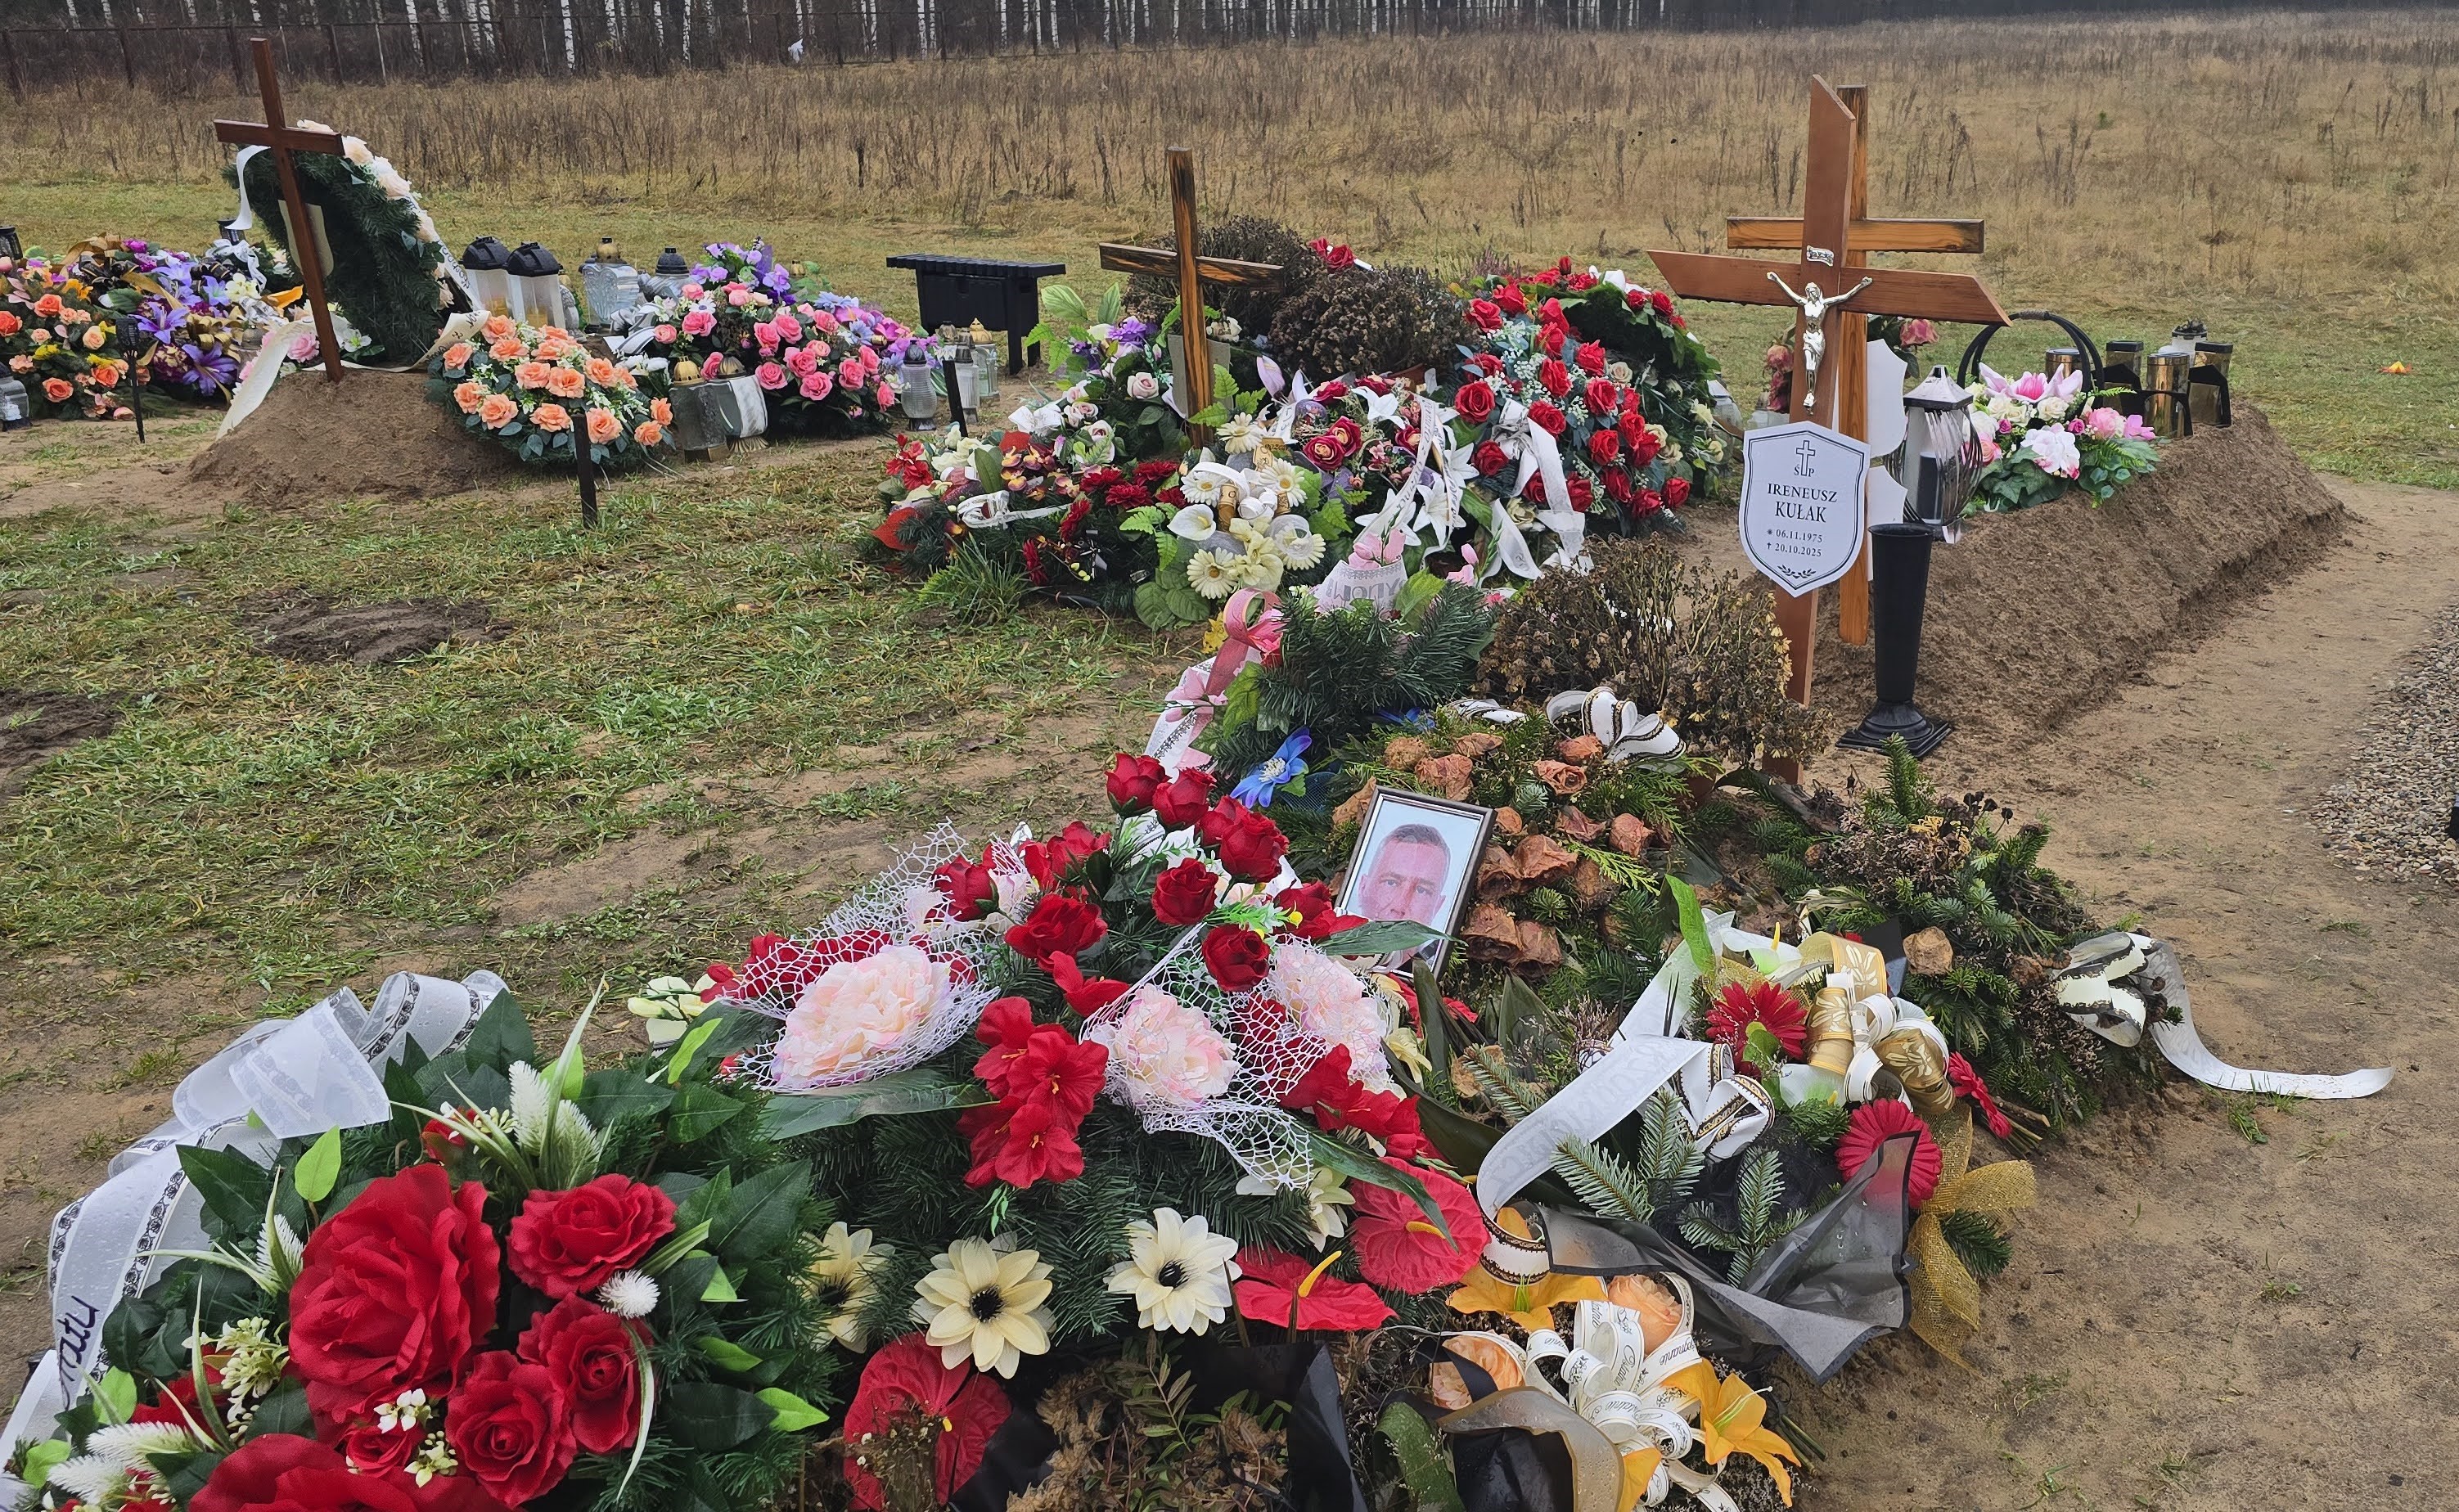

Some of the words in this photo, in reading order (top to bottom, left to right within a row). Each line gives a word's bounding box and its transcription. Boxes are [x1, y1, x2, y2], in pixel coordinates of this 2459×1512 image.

[1808, 467, 1815, 478] P
[1768, 483, 1838, 503] IRENEUSZ
[1775, 501, 1826, 523] KUŁAK
[1776, 529, 1823, 543] 06.11.1975
[1775, 542, 1822, 557] 20.10.2025
